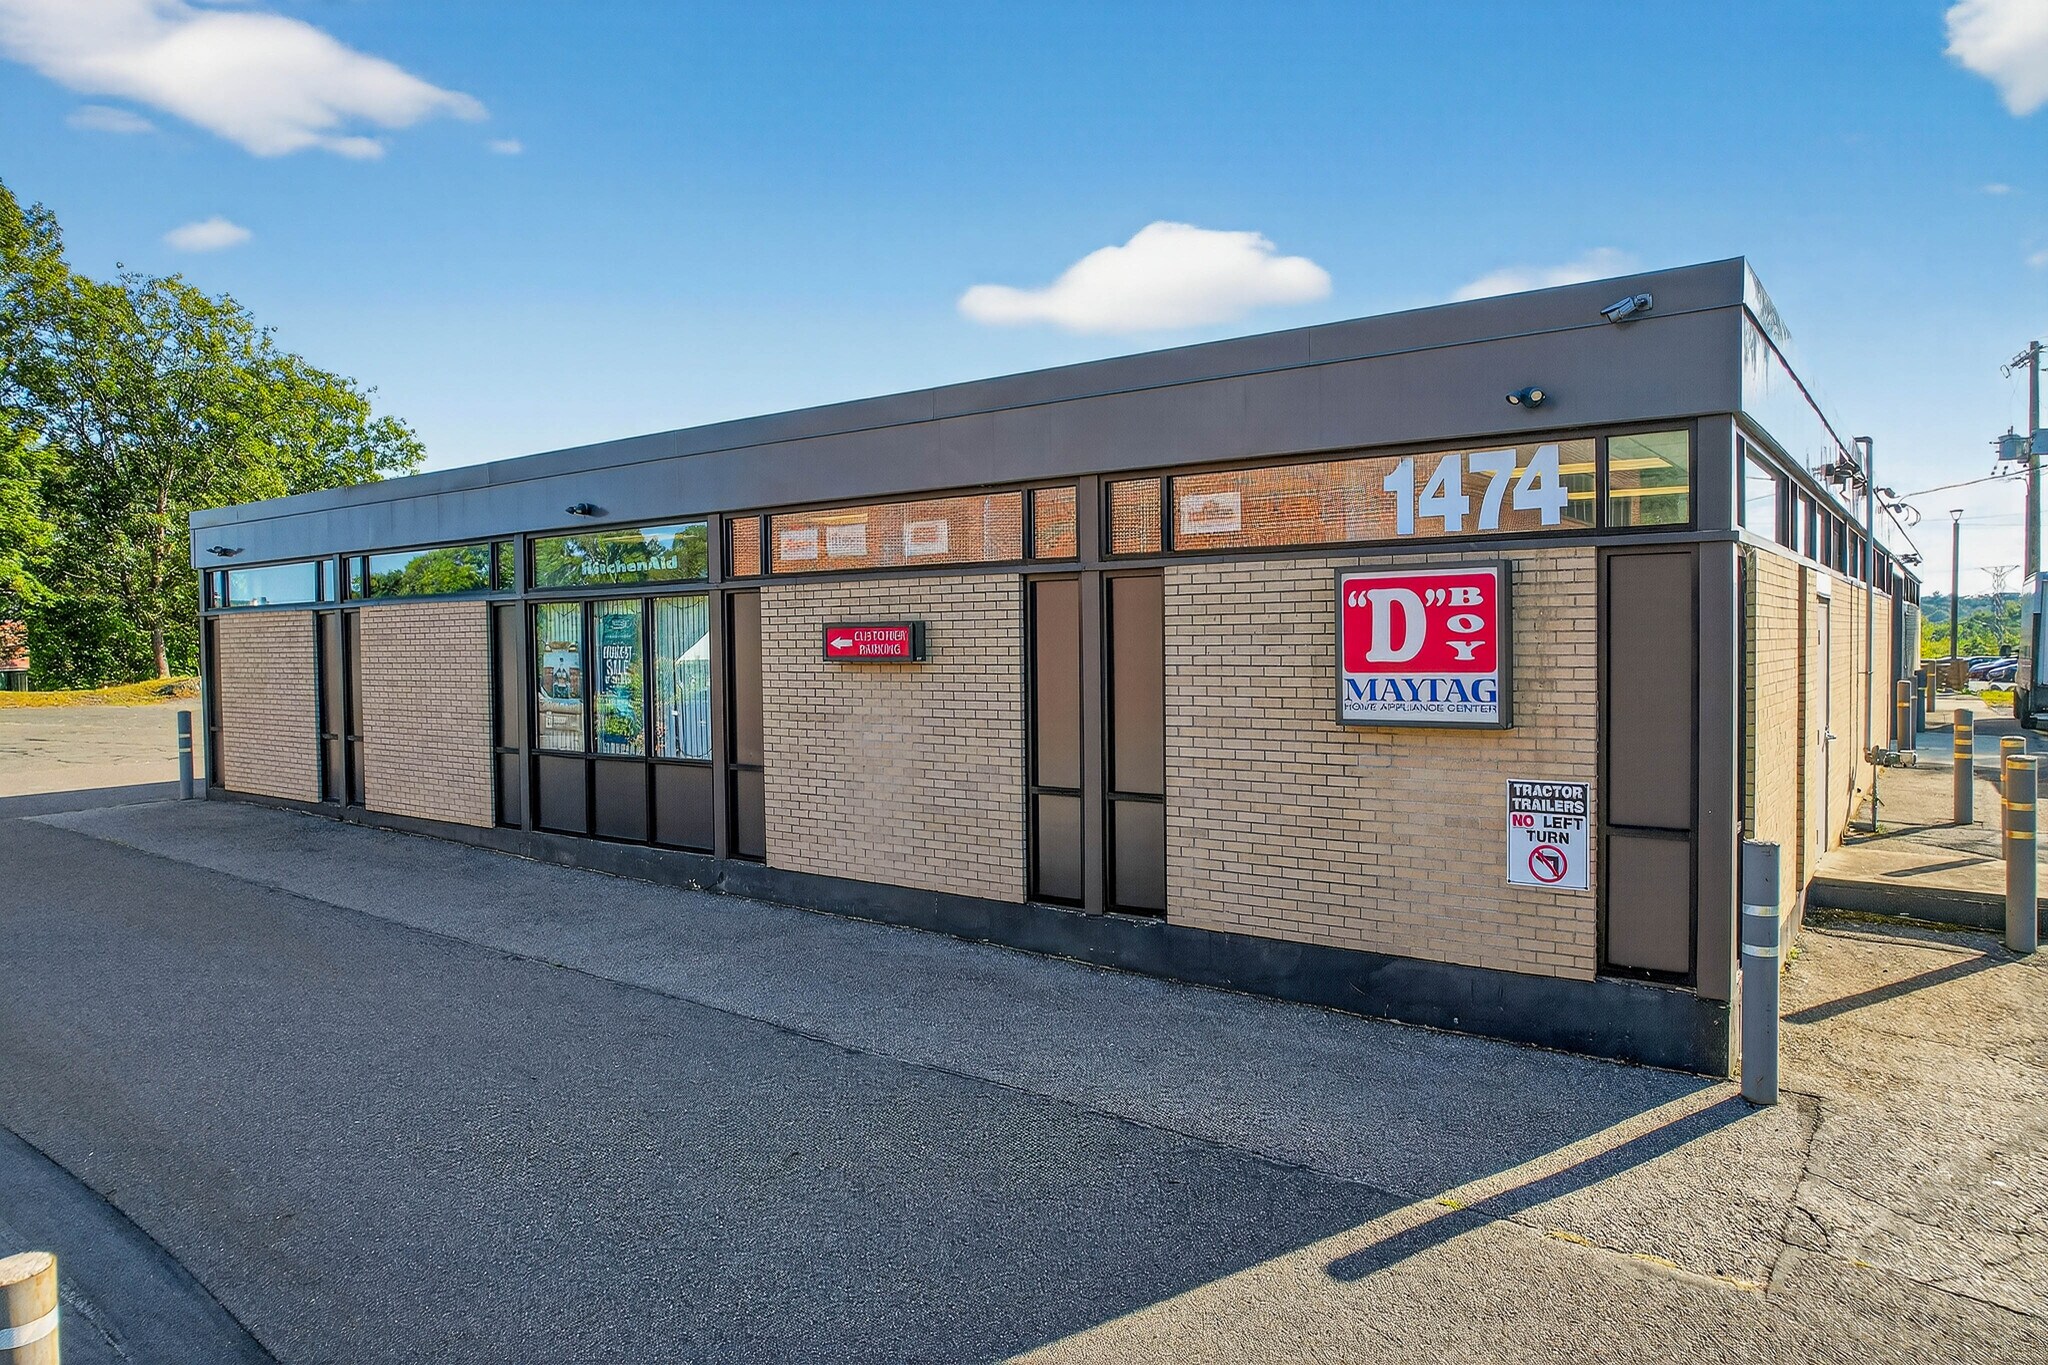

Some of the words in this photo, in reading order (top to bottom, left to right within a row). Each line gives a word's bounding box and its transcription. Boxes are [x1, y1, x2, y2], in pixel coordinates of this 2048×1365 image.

[1383, 444, 1569, 535] 1474
[1445, 586, 1486, 661] BOY
[854, 630, 907, 642] CUSTOMER
[859, 643, 901, 655] PARKING
[1344, 678, 1497, 703] MAYTAG
[1344, 702, 1377, 712] HOME
[1379, 703, 1445, 713] APPLIANCE
[1446, 704, 1498, 714] CENTER
[1513, 783, 1583, 799] TRACTOR
[1512, 797, 1584, 814] TRAILERS
[1512, 813, 1535, 828] NO
[1543, 815, 1584, 831] LEFT
[1526, 830, 1570, 845] TURN
